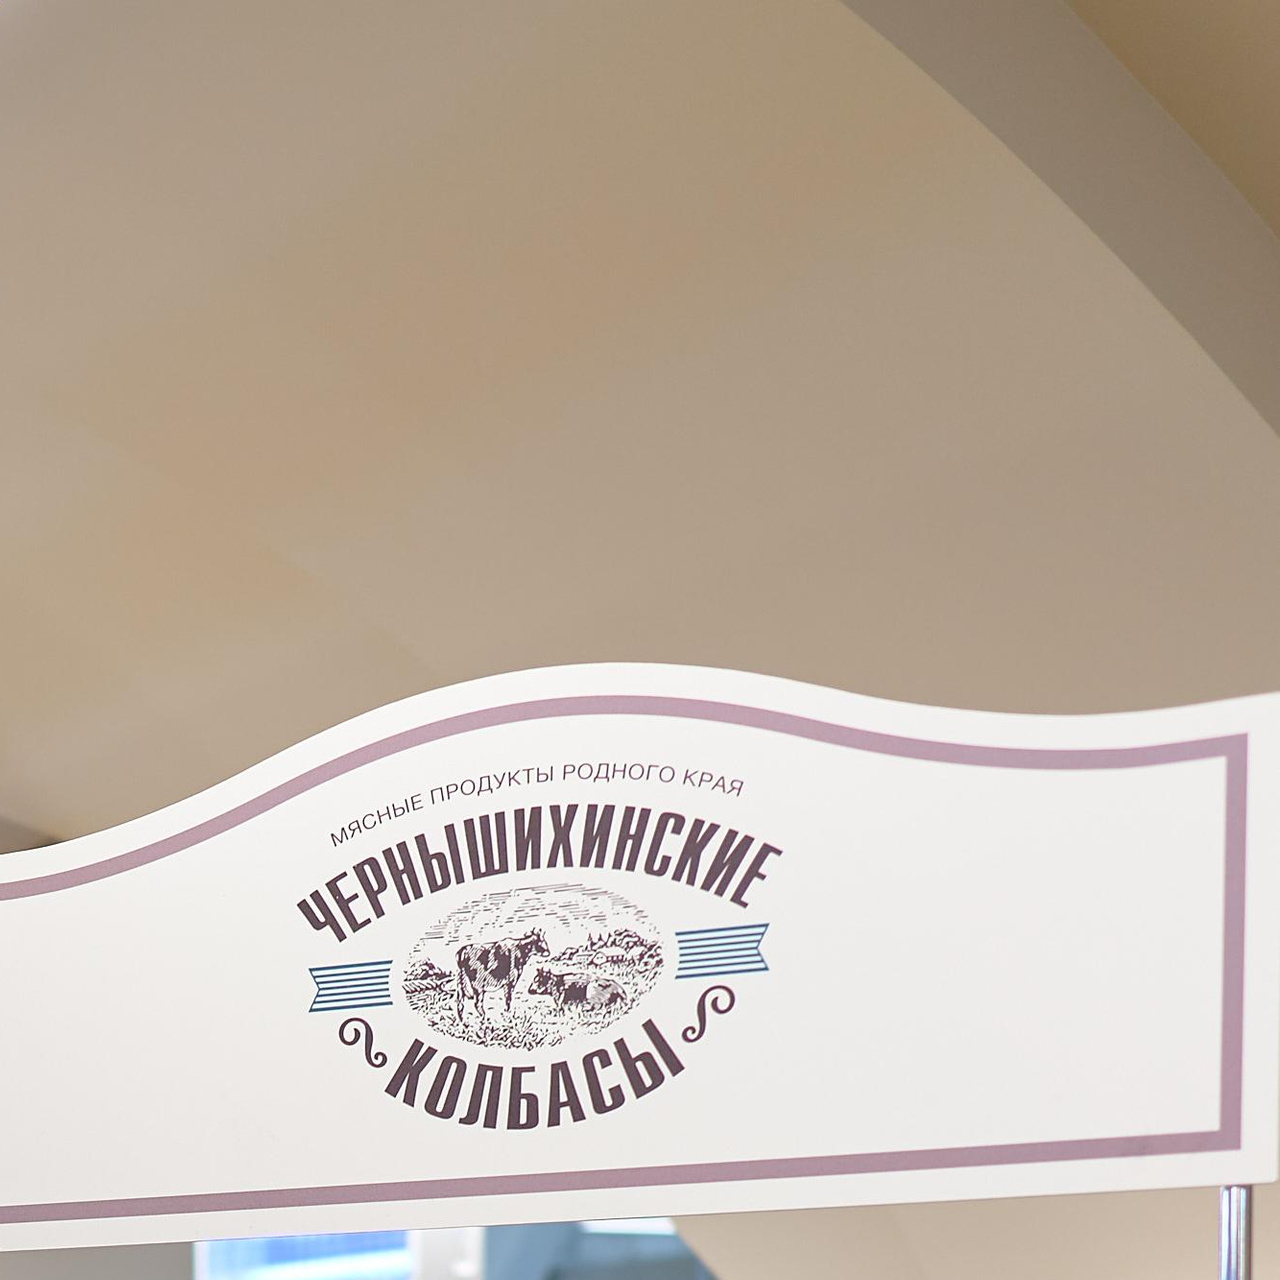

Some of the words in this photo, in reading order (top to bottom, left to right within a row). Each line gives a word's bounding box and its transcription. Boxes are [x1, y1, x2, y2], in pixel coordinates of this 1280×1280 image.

[330, 793, 424, 847] МЯСНЫЕ
[430, 765, 554, 805] ПРОДУКТЫ
[563, 762, 675, 784] РОДНОГО
[682, 769, 744, 797] КРАЯ
[296, 803, 783, 943] ЧЕРНЫШИХИНСКИЕ
[384, 1018, 685, 1131] КОЛБАСЫ
